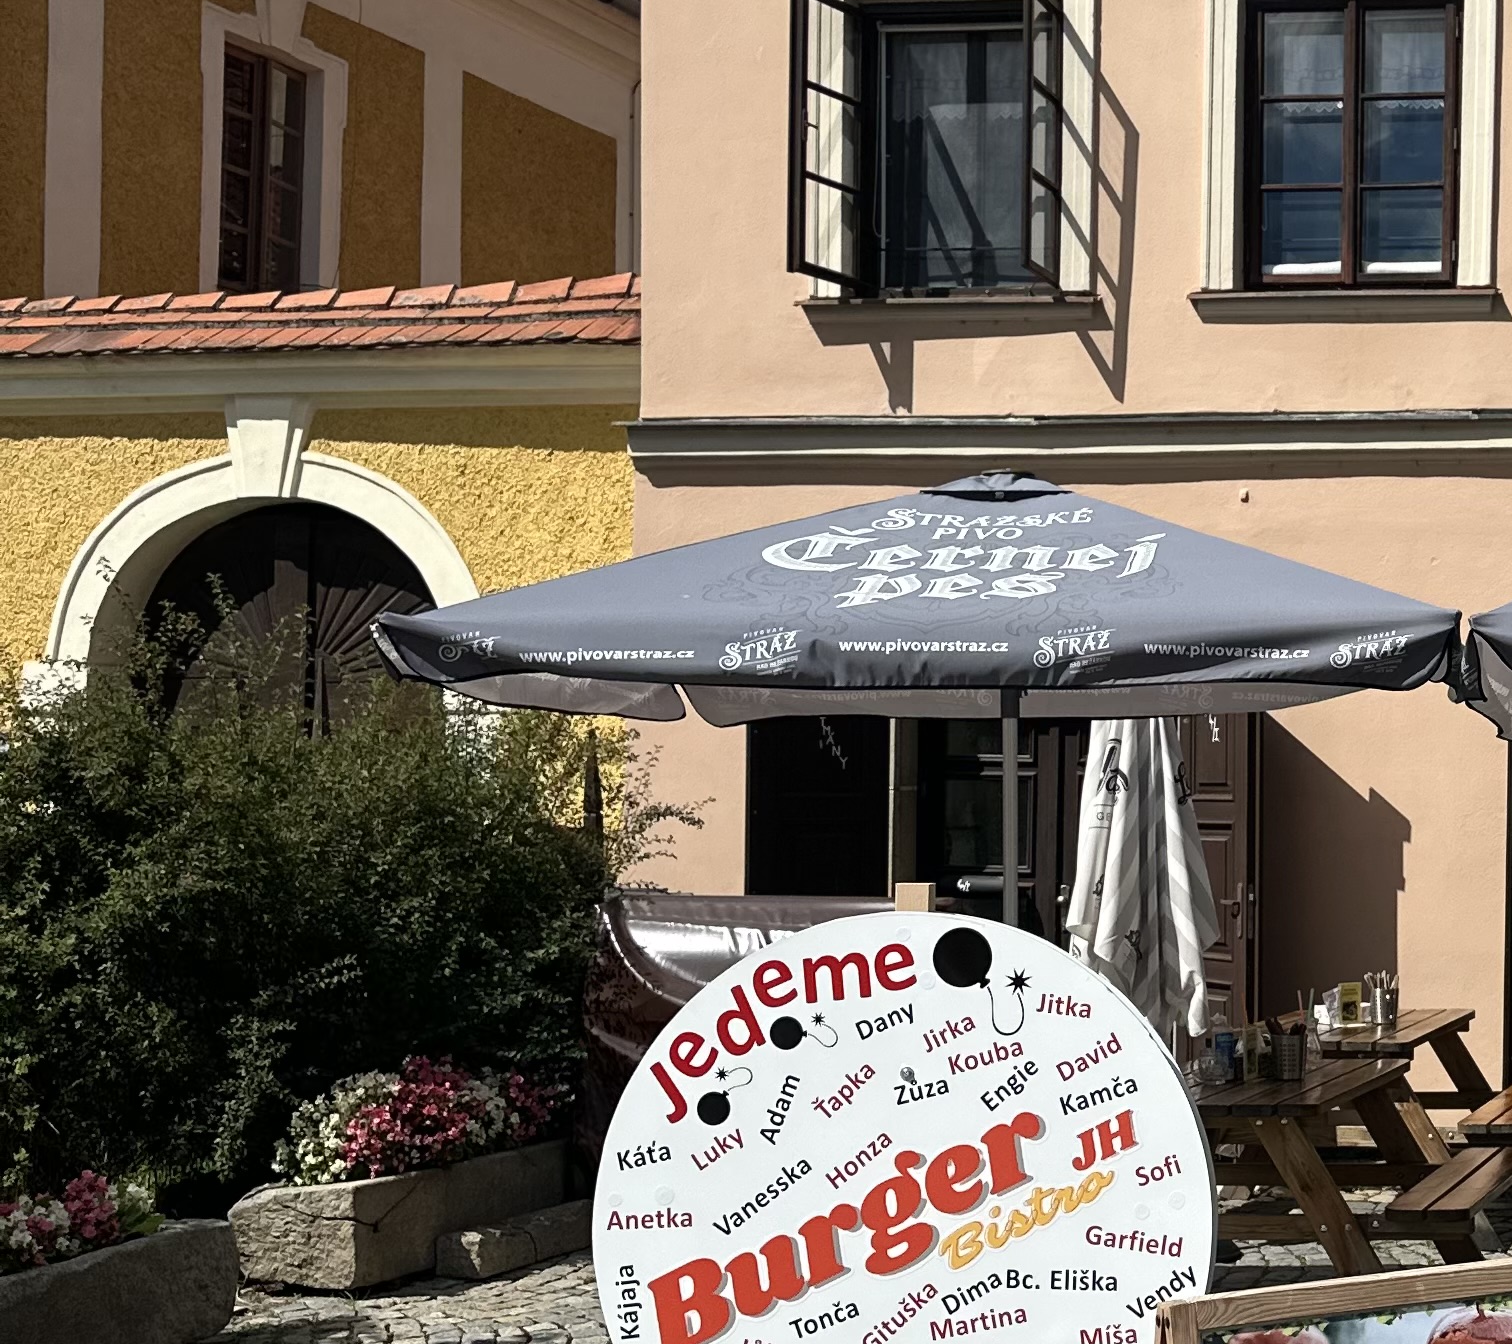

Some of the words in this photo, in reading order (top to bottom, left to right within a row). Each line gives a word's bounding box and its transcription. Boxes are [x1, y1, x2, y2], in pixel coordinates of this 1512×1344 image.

[761, 525, 1167, 578] Černej
[931, 527, 1024, 540] PIVO
[834, 571, 1066, 608] pes
[518, 648, 694, 665] www.pivovarstraz.cz
[839, 639, 1008, 653] www.pivovarstraz.cz
[1144, 642, 1310, 659] www.pivovarstraz.cz
[855, 1004, 913, 1040] Dany
[1036, 994, 1091, 1018] Jitka
[923, 1017, 975, 1052] Jirka
[948, 1042, 1023, 1075] Kouba
[1056, 1032, 1122, 1081] David
[811, 1065, 875, 1118] Ťapka
[981, 1061, 1038, 1111] Engie
[1060, 1076, 1138, 1115] Kamča
[760, 1075, 800, 1145] Adam
[617, 1141, 671, 1170] Káťa
[691, 1129, 743, 1170] Luky
[1072, 1109, 1138, 1170] JH
[825, 1133, 892, 1189] Honza
[1136, 1155, 1181, 1186] Sofi
[712, 1160, 812, 1235] Vanesska
[607, 1208, 692, 1230] Anetka
[940, 1171, 1114, 1270] Bistro
[1086, 1226, 1182, 1257] Garfield
[941, 1274, 1002, 1315] Dima
[1007, 1269, 1039, 1289] Bc.
[1051, 1270, 1117, 1291] Eliška
[1126, 1266, 1196, 1318] Vendy
[789, 1301, 859, 1338] Tonča
[930, 1309, 1027, 1340] Martina
